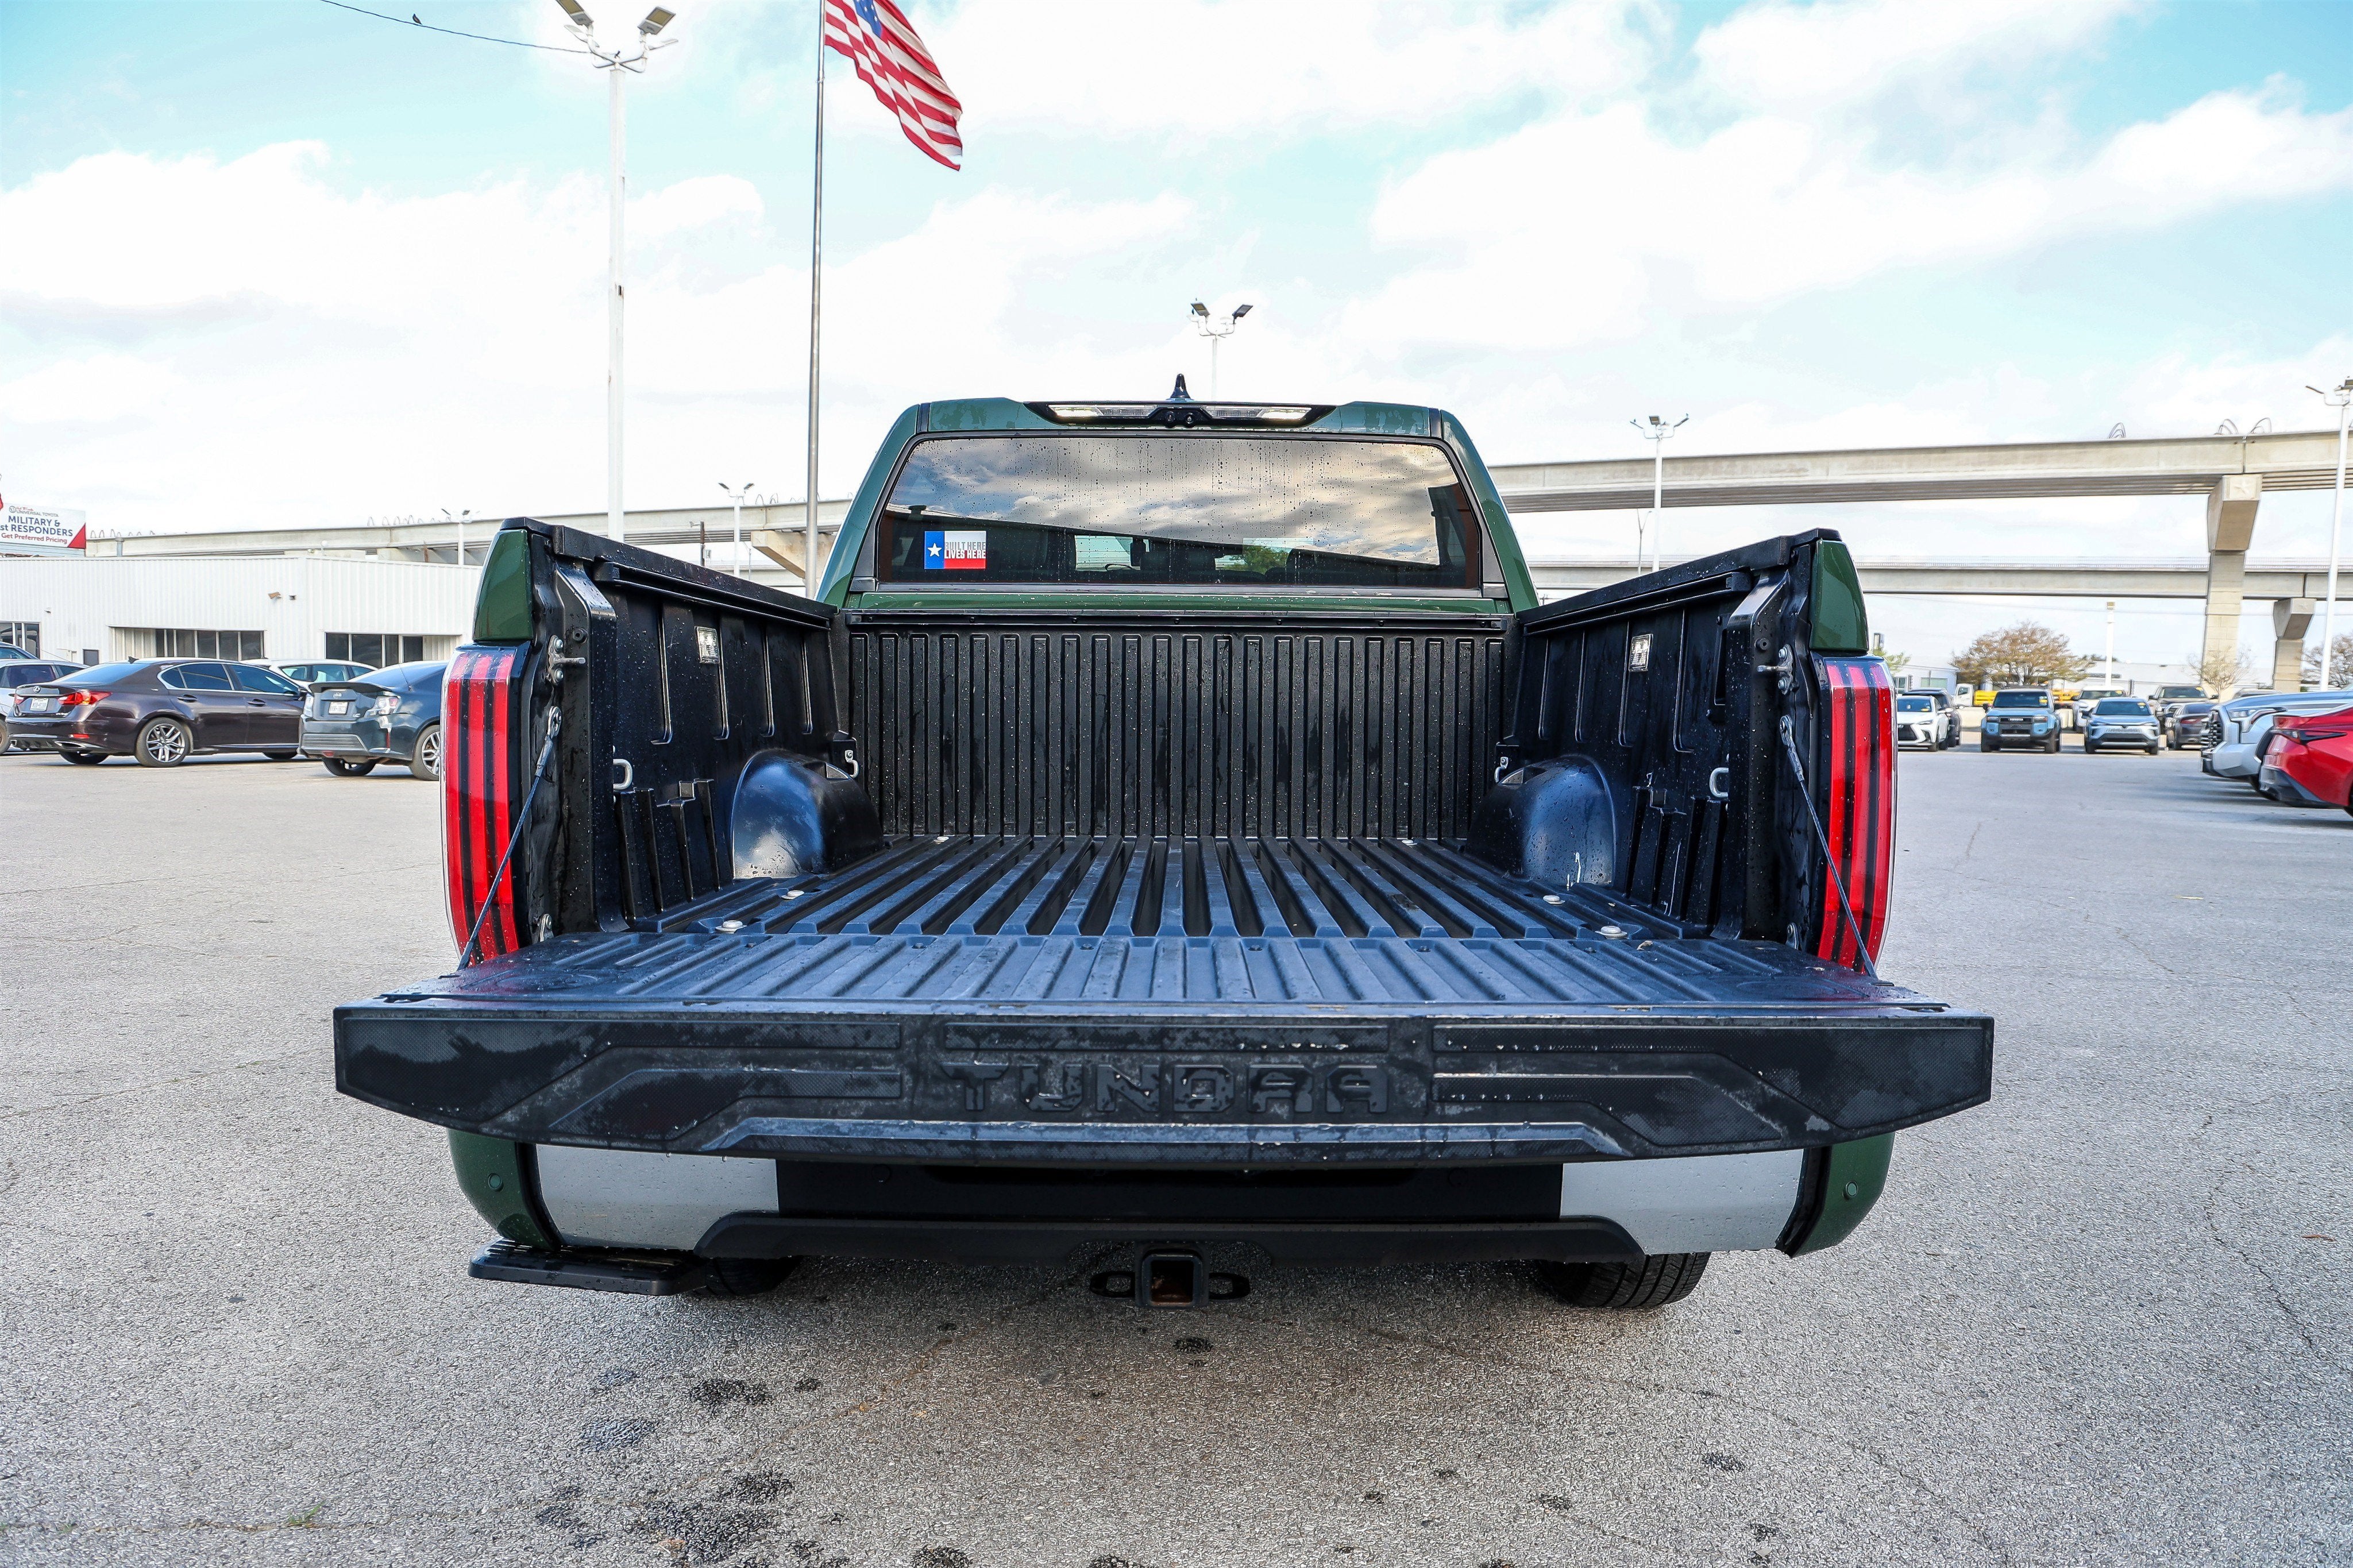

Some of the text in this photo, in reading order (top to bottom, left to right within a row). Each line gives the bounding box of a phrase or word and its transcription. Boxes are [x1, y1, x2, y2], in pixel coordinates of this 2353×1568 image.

[8, 515, 52, 527] MILITARY
[11, 524, 73, 537] RESPONDERS
[14, 534, 44, 542] Preferred
[46, 536, 67, 544] Pricing
[945, 542, 986, 550] BUILT HERE
[944, 550, 986, 559] LIVES HERE
[942, 1063, 1388, 1113] TUNDRA
